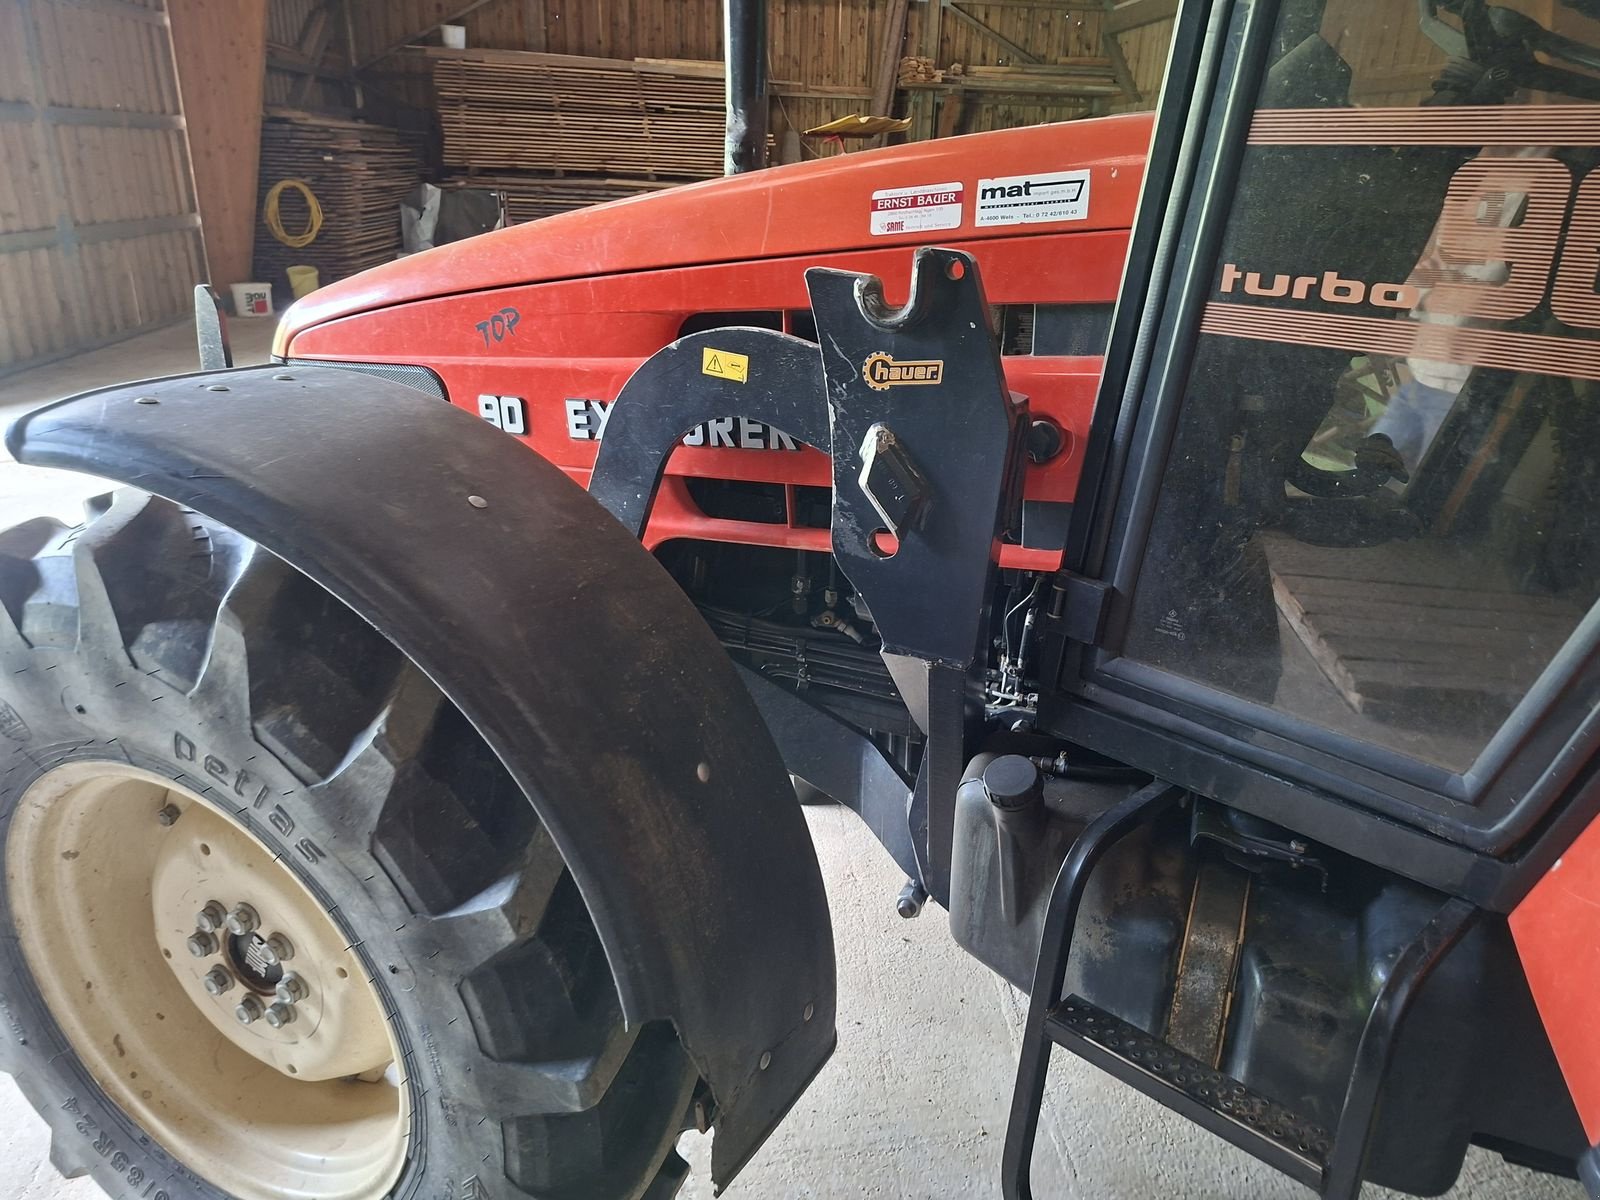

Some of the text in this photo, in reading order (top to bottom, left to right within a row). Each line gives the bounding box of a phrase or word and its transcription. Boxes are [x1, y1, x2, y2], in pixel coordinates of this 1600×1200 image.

[877, 193, 956, 210] ERNST BAUER
[981, 181, 1031, 200] mat
[886, 221, 904, 232] SAME
[1220, 263, 1420, 309] turbo
[475, 307, 521, 349] TOP
[478, 394, 526, 434] 90
[565, 399, 797, 450] EXRE
